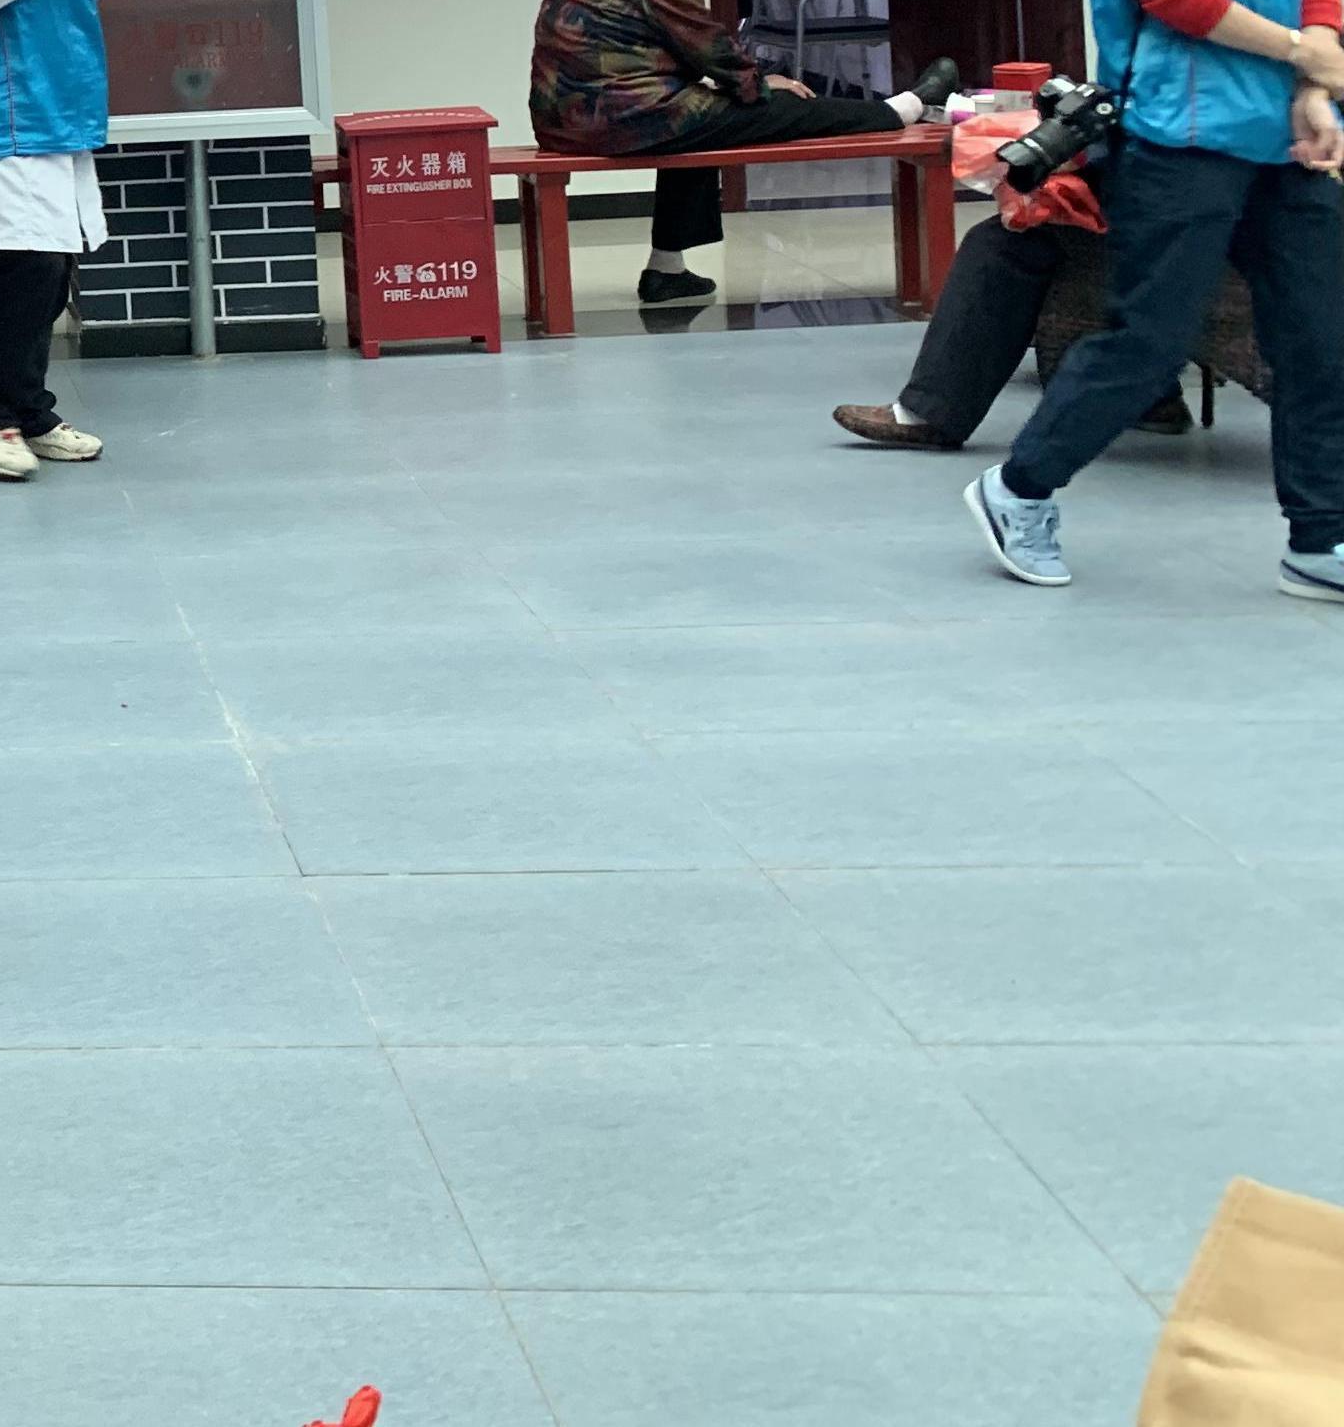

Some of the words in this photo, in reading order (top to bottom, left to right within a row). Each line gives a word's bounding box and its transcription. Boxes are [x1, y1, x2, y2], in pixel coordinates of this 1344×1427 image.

[369, 150, 467, 179] 灭火器箱
[366, 183, 386, 194] FIRE
[453, 177, 473, 190] BOX
[383, 285, 468, 303] FIRE-ALARM
